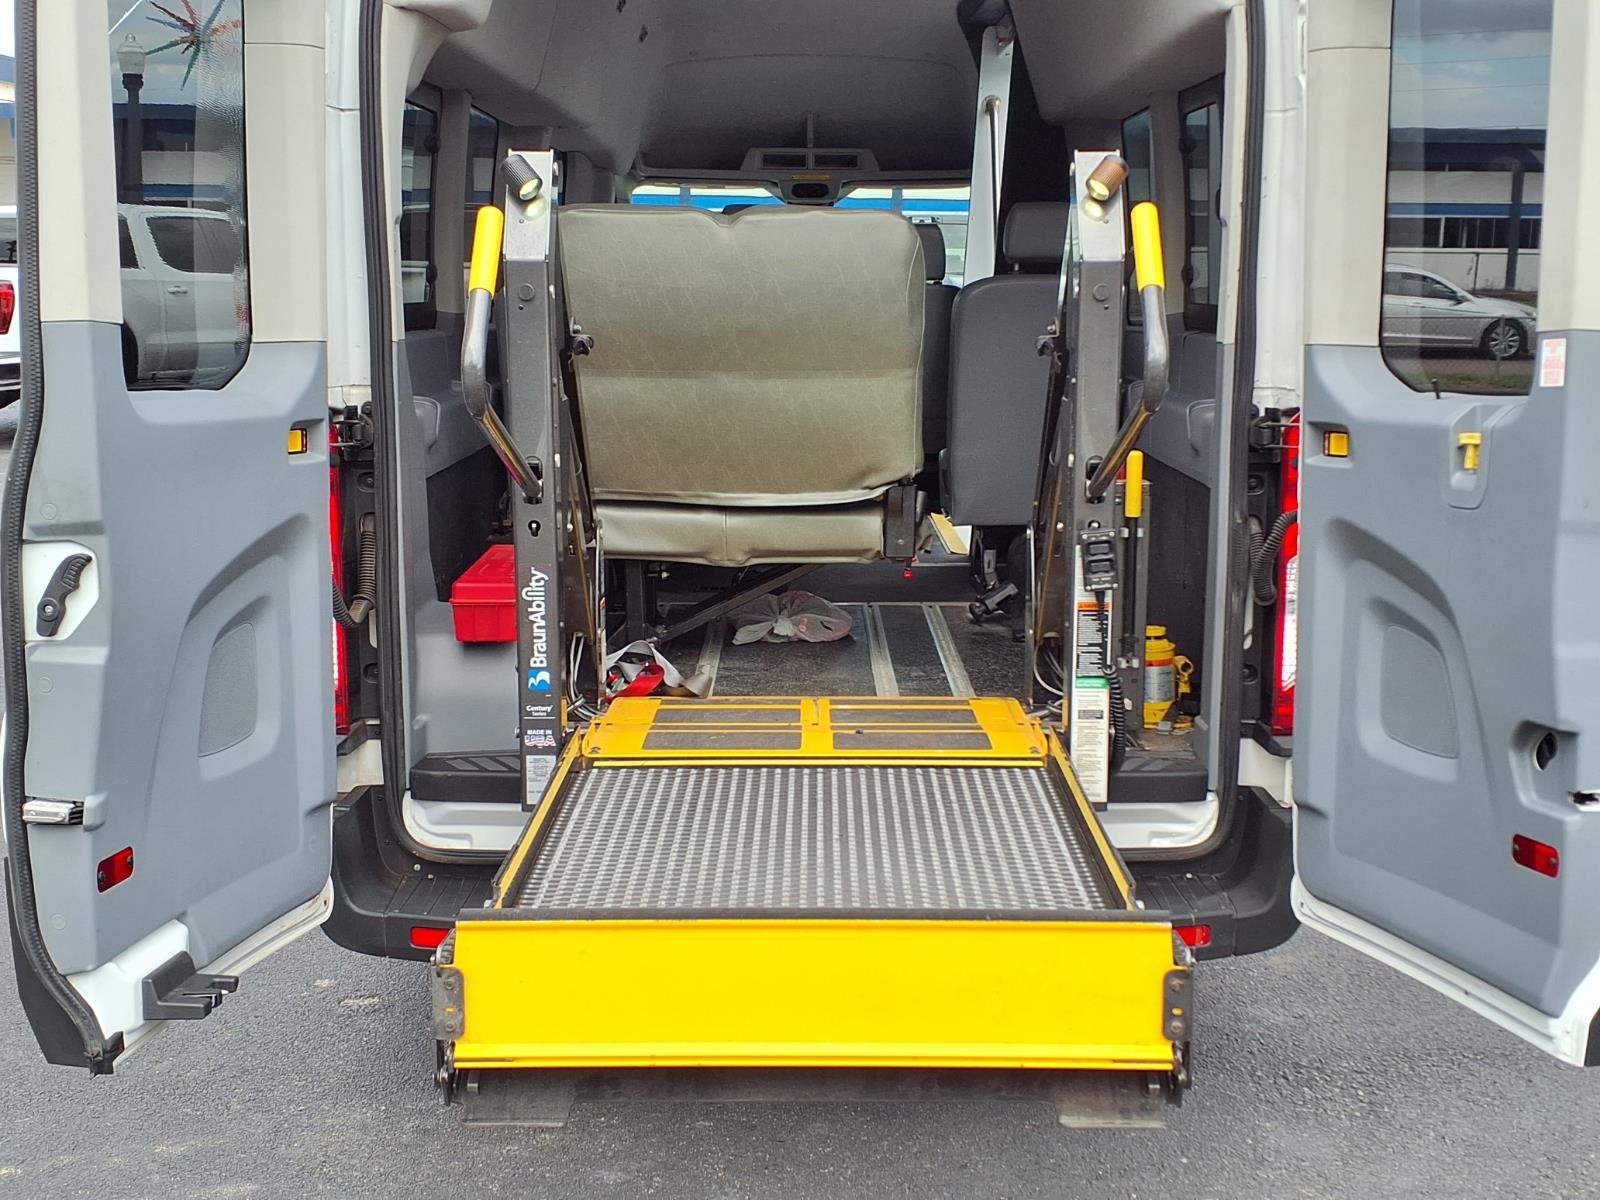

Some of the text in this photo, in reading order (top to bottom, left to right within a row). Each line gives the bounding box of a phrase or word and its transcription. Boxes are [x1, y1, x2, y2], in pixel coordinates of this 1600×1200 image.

[521, 570, 549, 668] BraunAbility
[526, 705, 553, 713] Century
[524, 735, 557, 746] USA
